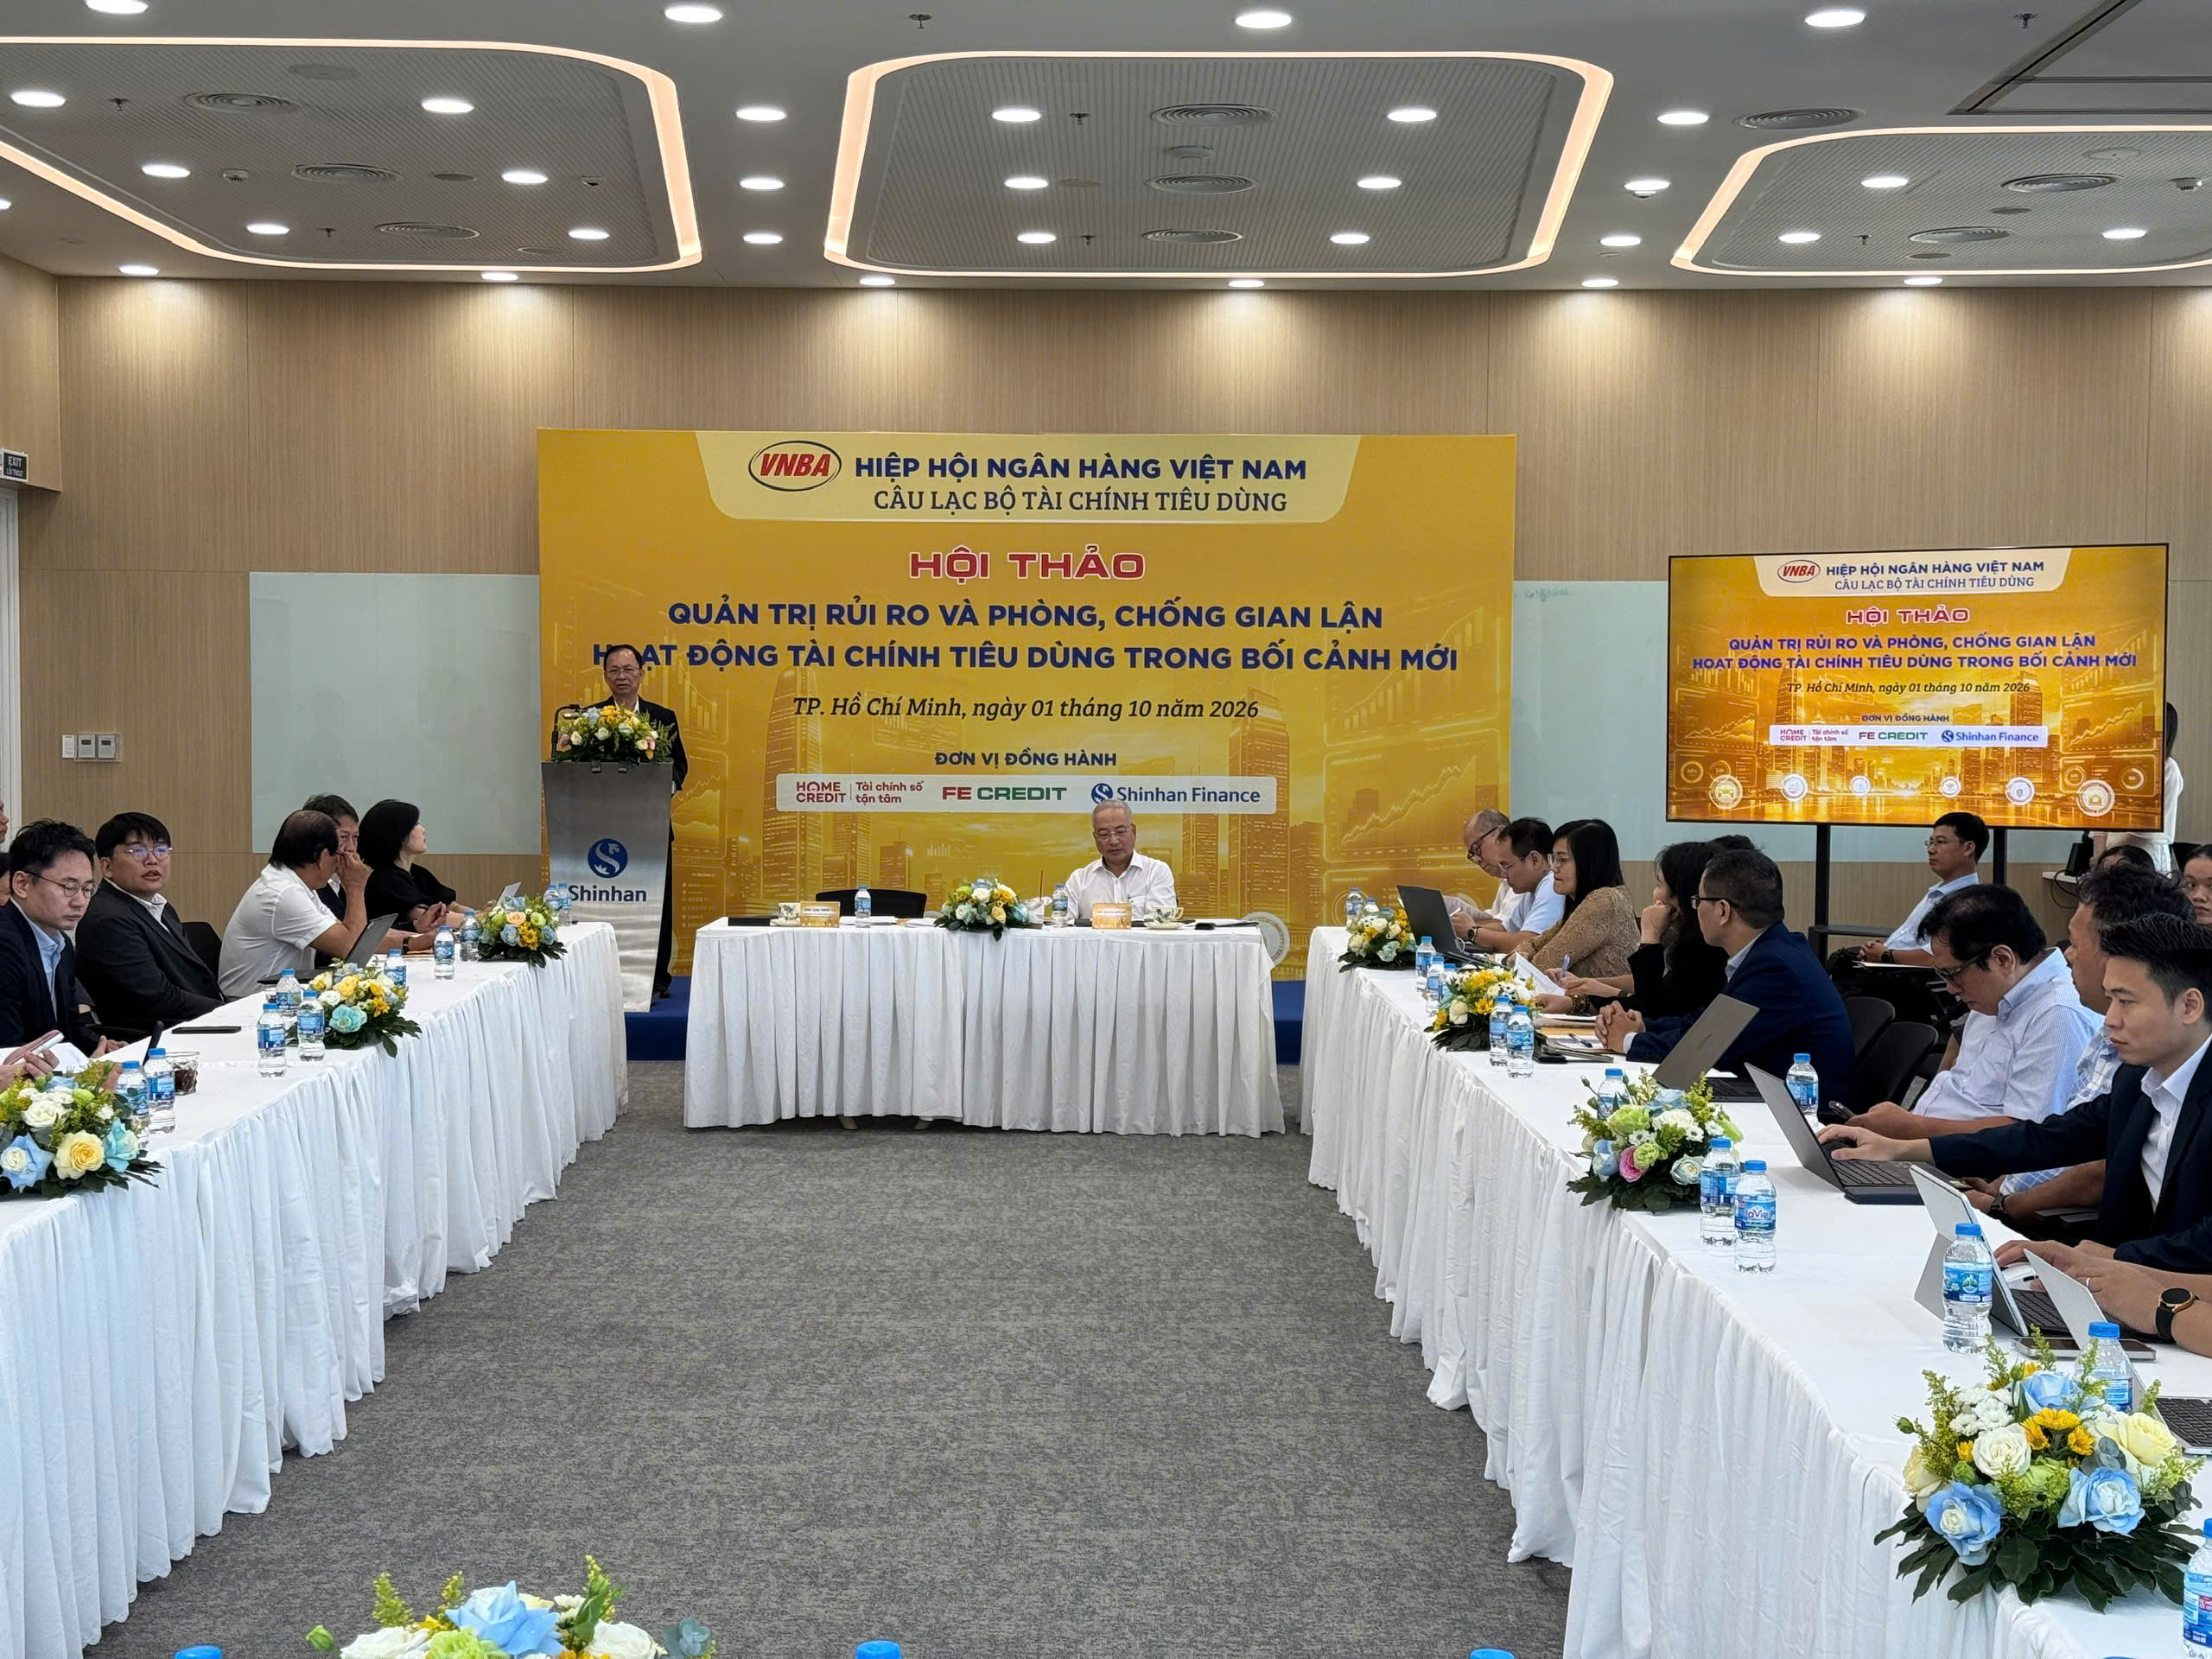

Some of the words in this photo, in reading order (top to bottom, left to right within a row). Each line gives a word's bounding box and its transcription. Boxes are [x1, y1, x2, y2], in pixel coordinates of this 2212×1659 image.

[8, 456, 22, 467] EXIT
[760, 454, 831, 477] VNBA
[855, 452, 919, 482] HIỆP
[928, 452, 977, 483] HỘI
[987, 453, 1070, 478] NGÂN
[1078, 453, 1161, 480] HÀNG
[1170, 454, 1233, 484] VIỆT
[1242, 459, 1306, 480] NAM
[874, 486, 924, 510] CÂU
[931, 492, 977, 515] LẠC
[983, 486, 1016, 516] BỘ
[1022, 486, 1062, 511] TÀI
[1069, 486, 1148, 511] CHÍNH
[1155, 487, 1211, 512] TIÊU
[1217, 488, 1287, 512] DÙNG
[911, 546, 989, 584] HỘI
[1008, 545, 1145, 578] THẢO
[1783, 565, 1815, 576] VNBA
[1827, 563, 1857, 578] HIỆP
[1860, 563, 1884, 577] HỘI
[1888, 562, 1928, 574] NGÂN
[1932, 561, 1972, 574] HÀNG
[1977, 560, 2008, 575] VIỆT
[2012, 562, 2044, 572] NAM
[1835, 578, 1859, 590] CÂU
[1861, 580, 1884, 592] LẠC
[1886, 577, 1902, 592] BỘ
[1905, 577, 1924, 588] TÀI
[1927, 576, 1966, 588] CHÍNH
[1969, 575, 1996, 588] TIÊU
[1999, 575, 2035, 587] DÙNG
[669, 594, 759, 624] QUẢN
[768, 604, 816, 631] TRỊ
[826, 595, 876, 625] RỦI
[887, 604, 930, 626] RO
[939, 598, 979, 626] VÀ
[988, 599, 1105, 631] PHÒNG,
[1115, 596, 1224, 628] CHỐNG
[1236, 607, 1311, 628] GIAN
[1321, 601, 1382, 633] LẬN
[1847, 607, 1888, 626] HỘI
[1897, 605, 1969, 623] THẢO
[1729, 634, 1773, 650] QUẢN
[1777, 639, 1801, 652] TRỊ
[1806, 633, 1831, 649] RỦI
[1835, 638, 1858, 649] RO
[1862, 635, 1883, 649] VÀ
[1887, 634, 1948, 650] PHÒNG,
[1953, 632, 2011, 648] CHỐNG
[2016, 636, 2056, 647] GIAN
[2062, 632, 2095, 650] LẬN
[594, 644, 677, 671] HẠT
[688, 639, 778, 671] ĐỘNG
[787, 639, 835, 666] TÀI
[845, 639, 939, 667] CHÍNH
[950, 640, 1018, 668] TIÊU
[1027, 640, 1114, 669] DÙNG
[1125, 647, 1231, 670] TRONG
[1242, 638, 1294, 670] BỐI
[1303, 639, 1390, 671] CẢNH
[1402, 640, 1458, 671] MỚI
[1693, 658, 1733, 671] HOẠT
[1738, 655, 1783, 671] ĐỘNG
[1786, 655, 1810, 668] TÀI
[1815, 655, 1863, 668] CHÍNH
[1867, 654, 1903, 668] TIÊU
[1907, 654, 1953, 668] DÙNG
[1957, 656, 2014, 668] TRONG
[2018, 651, 2047, 667] BỐI
[2052, 651, 2100, 666] CẢNH
[2105, 652, 2137, 666] MỚI
[1788, 683, 1803, 692] TP.
[1807, 681, 1821, 692] Hồ
[1824, 682, 1842, 692] Chí
[1845, 683, 1875, 694] Minh,
[1878, 683, 1906, 695] ngày
[1909, 683, 1921, 692] 01
[1923, 682, 1957, 695] tháng
[1960, 683, 1973, 692] 10
[2003, 683, 2031, 692] 2026
[792, 697, 825, 715] TP.
[830, 691, 861, 715] Hồ
[868, 695, 903, 716] Chí
[907, 696, 967, 721] Minh,
[972, 696, 1027, 722] ngày
[1031, 699, 1054, 717] 01
[1060, 696, 1122, 722] tháng
[1128, 700, 1152, 717] 10
[1156, 698, 1204, 718] năm
[1209, 700, 1259, 718] 2026
[1884, 715, 1892, 723] VỊ
[1923, 713, 1949, 721] HÀNH
[1955, 732, 1996, 741] Shinhan
[1999, 732, 2039, 741] Finance
[934, 750, 976, 766] ĐƠN
[982, 752, 999, 769] VỊ
[1004, 747, 1059, 766] ĐỒNG
[1064, 749, 1117, 766] HÀNH
[796, 781, 841, 792] HOME
[855, 781, 873, 791] Tài
[875, 781, 907, 791] chính
[909, 780, 924, 792] số
[942, 786, 972, 800] FE
[977, 786, 1067, 801] CREDIT
[796, 792, 847, 804] CREDIT
[855, 794, 875, 805] tận
[878, 794, 902, 804] tâm
[1117, 787, 1188, 802] Shinhan
[1192, 787, 1261, 803] Finance
[569, 885, 647, 902] Shinhan
